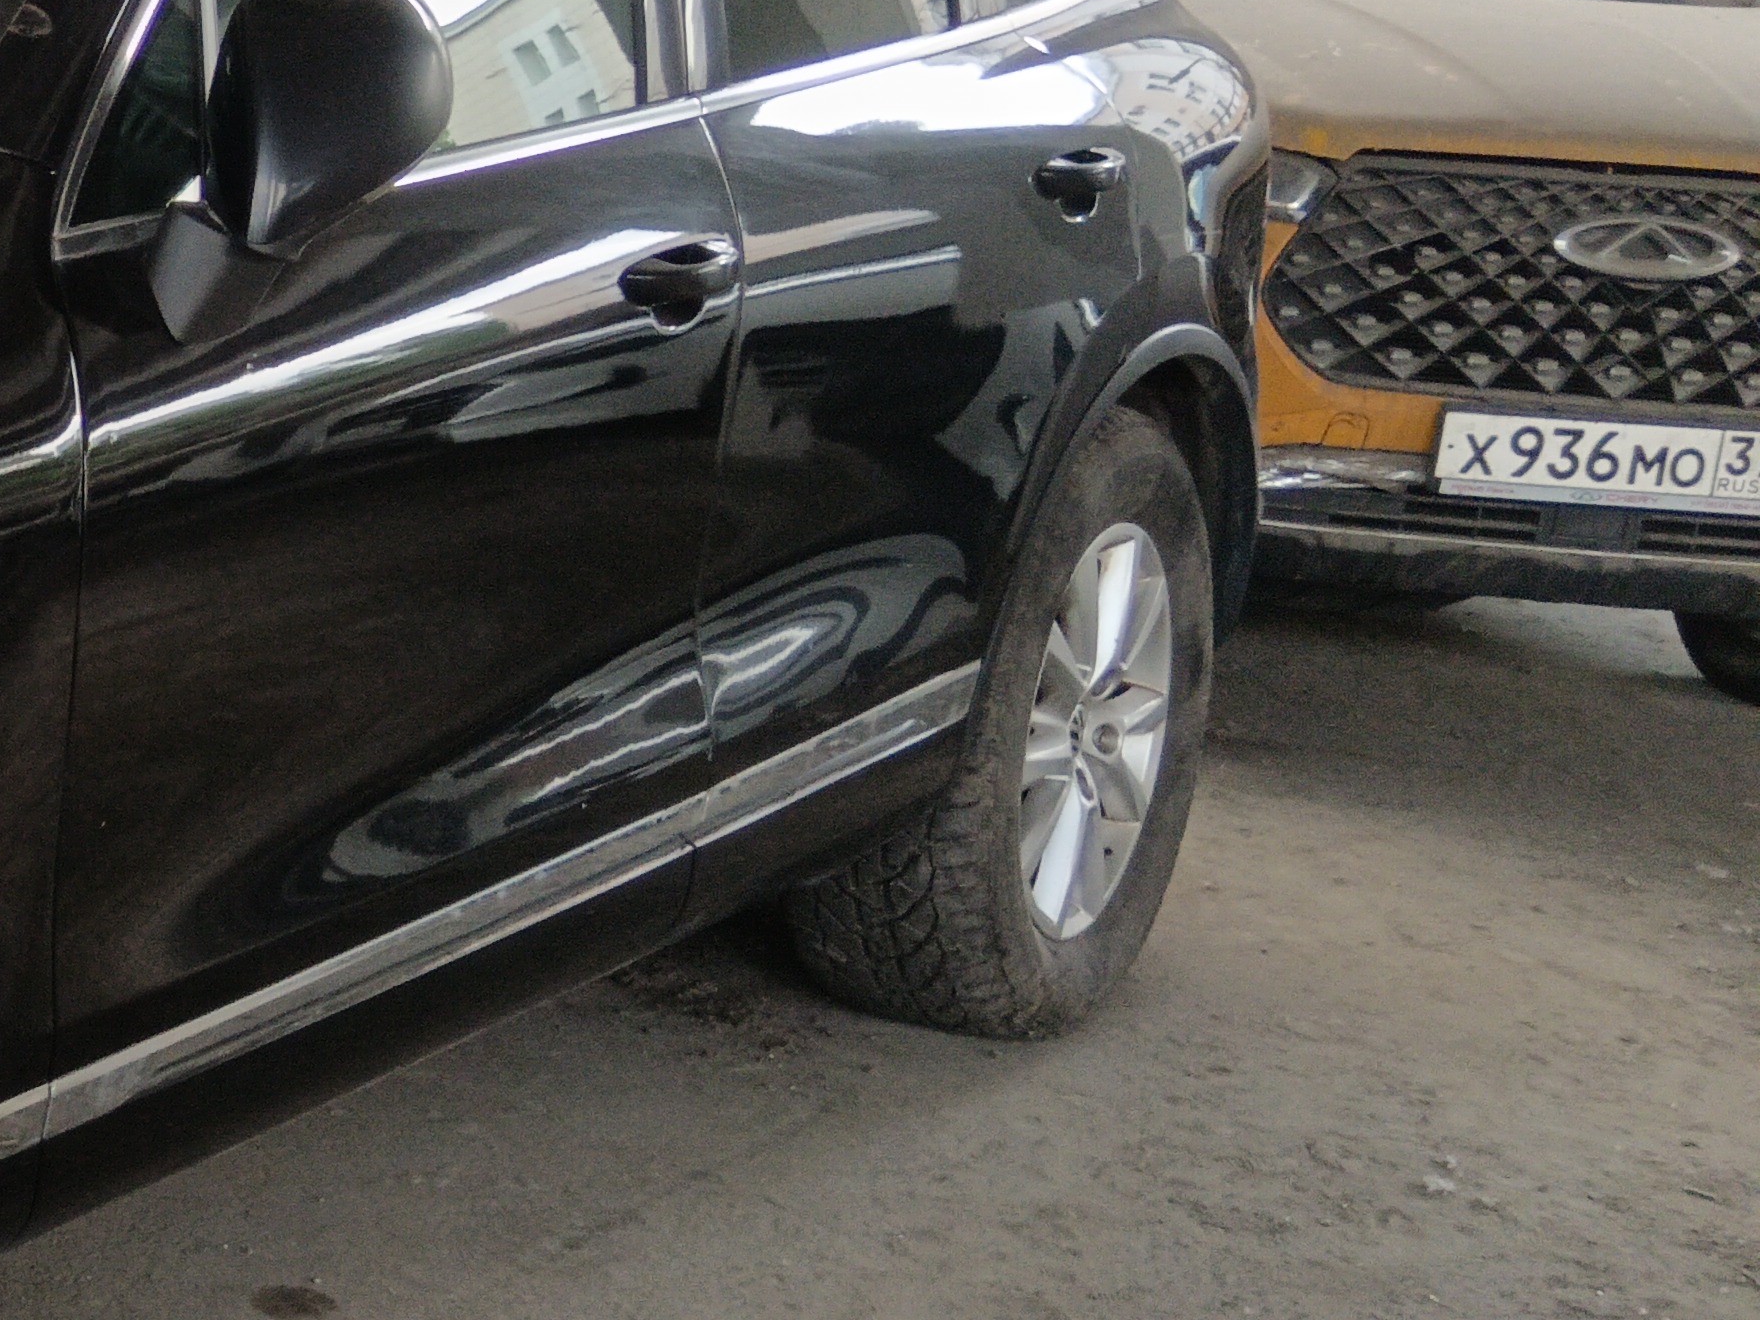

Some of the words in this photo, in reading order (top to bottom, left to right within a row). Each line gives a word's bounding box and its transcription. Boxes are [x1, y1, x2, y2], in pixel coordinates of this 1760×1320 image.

[1459, 426, 1705, 488] Х936МО
[1725, 435, 1760, 477] 3
[1716, 477, 1759, 494] RUS
